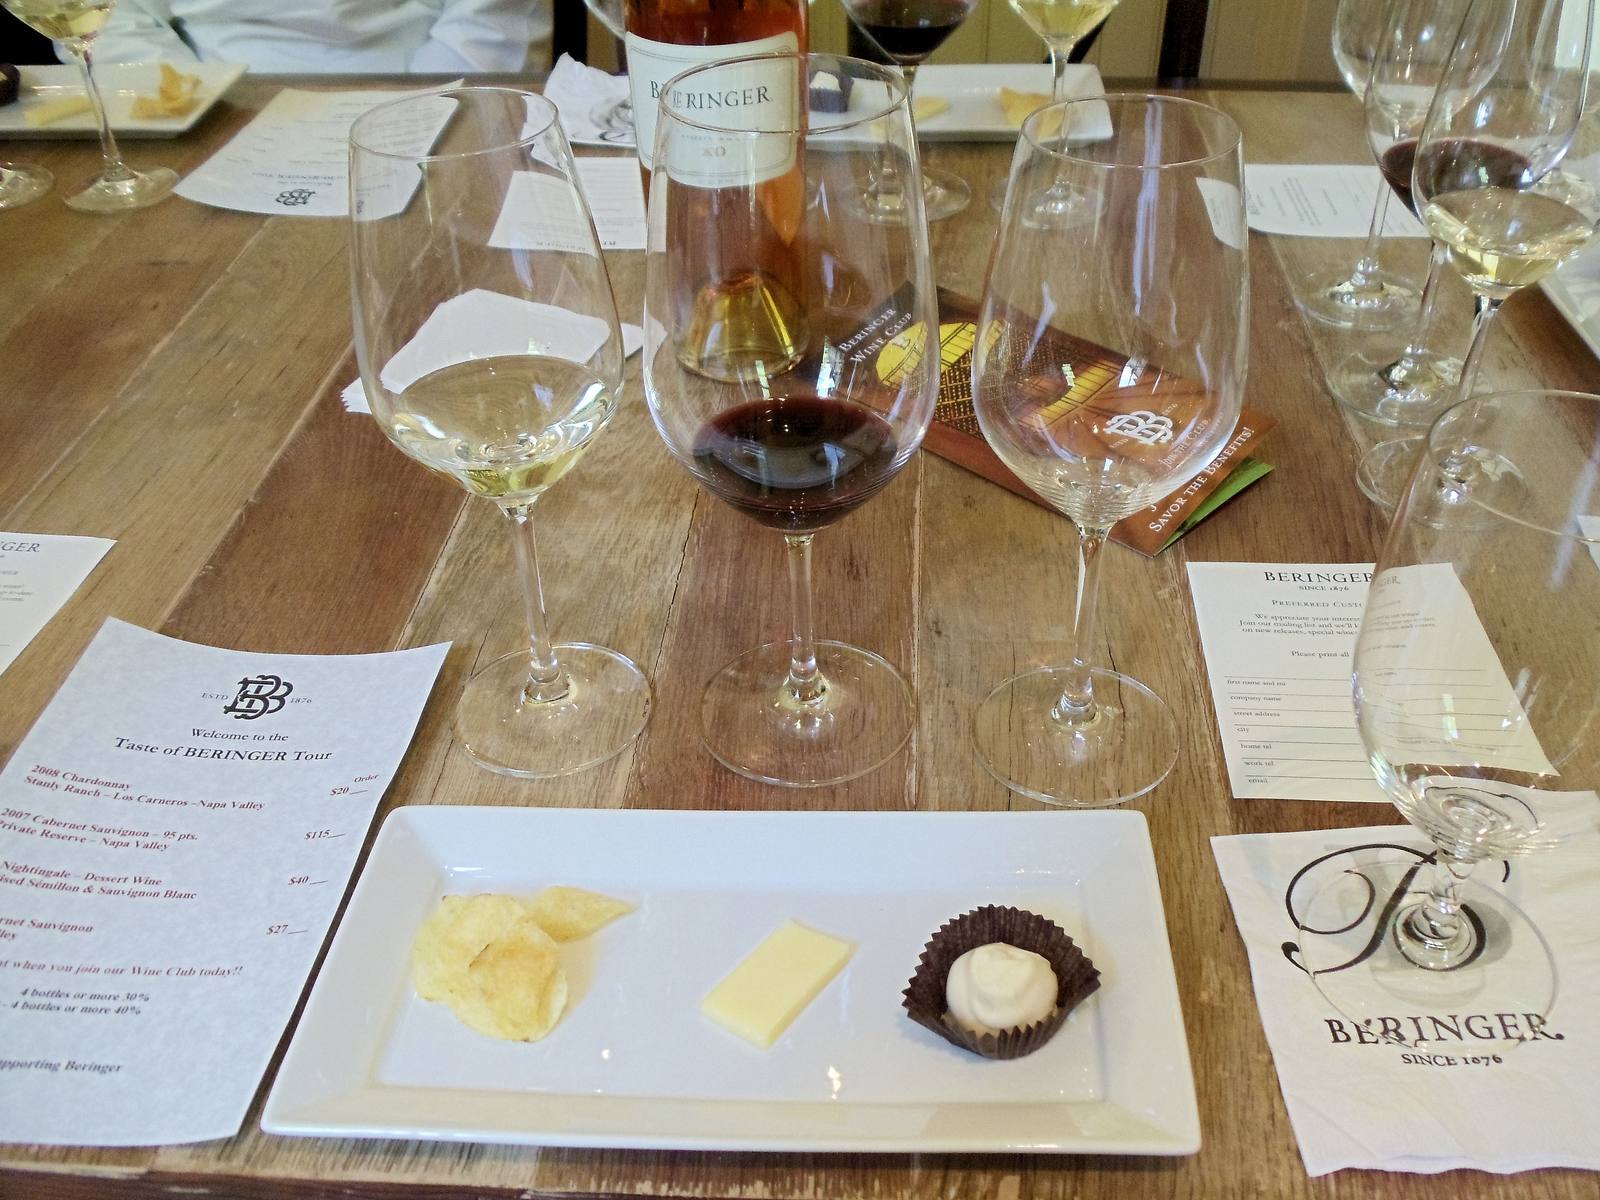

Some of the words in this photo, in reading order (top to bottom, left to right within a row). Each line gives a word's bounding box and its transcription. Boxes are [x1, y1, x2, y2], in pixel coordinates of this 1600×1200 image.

[838, 308, 897, 352] BERINGER
[850, 337, 887, 363] WINE
[885, 312, 912, 336] CLUB
[1148, 496, 1188, 532] SAVOR
[1184, 475, 1208, 496] THE
[1204, 426, 1256, 475] BENEFITS!
[1271, 599, 1330, 608] PREFERRED
[1273, 621, 1304, 629] mailing
[1307, 629, 1334, 637] special
[1291, 650, 1316, 658] Please
[201, 691, 229, 701] ESTD
[289, 696, 313, 704] 1876
[192, 728, 249, 741] Welcome
[252, 733, 265, 741] to
[268, 733, 289, 741] the
[115, 737, 159, 753] Taste
[162, 745, 184, 756] of
[183, 747, 288, 761] BERINGER
[293, 751, 333, 761] Tour
[31, 764, 60, 778] 2008
[62, 771, 132, 792] Chardonnay
[353, 773, 380, 783] Order
[24, 775, 59, 792] Stanly
[63, 784, 101, 798] Ranch
[113, 792, 134, 801] Los
[137, 795, 188, 807] Carneros
[231, 801, 265, 811] Valley
[329, 786, 350, 796] $20
[1, 807, 32, 821] 2007
[32, 815, 88, 831] Cabernet
[89, 823, 150, 838] Sauvignon
[163, 830, 177, 840] 95
[177, 832, 199, 842] pts.
[40, 828, 87, 843] Reserve
[101, 837, 131, 849] Napa
[134, 841, 170, 852] Valley
[303, 829, 331, 840] $115
[3, 859, 71, 879] Nightingale
[84, 872, 129, 884] Dessert
[132, 875, 163, 886] Wine
[287, 875, 309, 886] $40
[82, 884, 94, 894] &
[98, 886, 161, 899] Sauvignon
[163, 889, 198, 900] Blanc
[28, 919, 94, 932] Sauvignon
[266, 924, 289, 935] $27
[13, 960, 46, 972] when
[49, 962, 73, 974] you
[74, 962, 101, 976] join
[103, 967, 127, 975] our
[131, 966, 163, 976] Wine
[166, 967, 196, 976] Club
[199, 965, 244, 979] today!!
[30, 988, 70, 999] bottles
[73, 992, 88, 1000] or
[89, 993, 120, 1001] more
[20, 1001, 61, 1012] bottles
[64, 1004, 79, 1013] or
[80, 1005, 112, 1014] more
[1324, 1012, 1565, 1046] BERINGER
[1401, 1053, 1458, 1066] SINCE
[64, 1060, 124, 1074] Beringer
